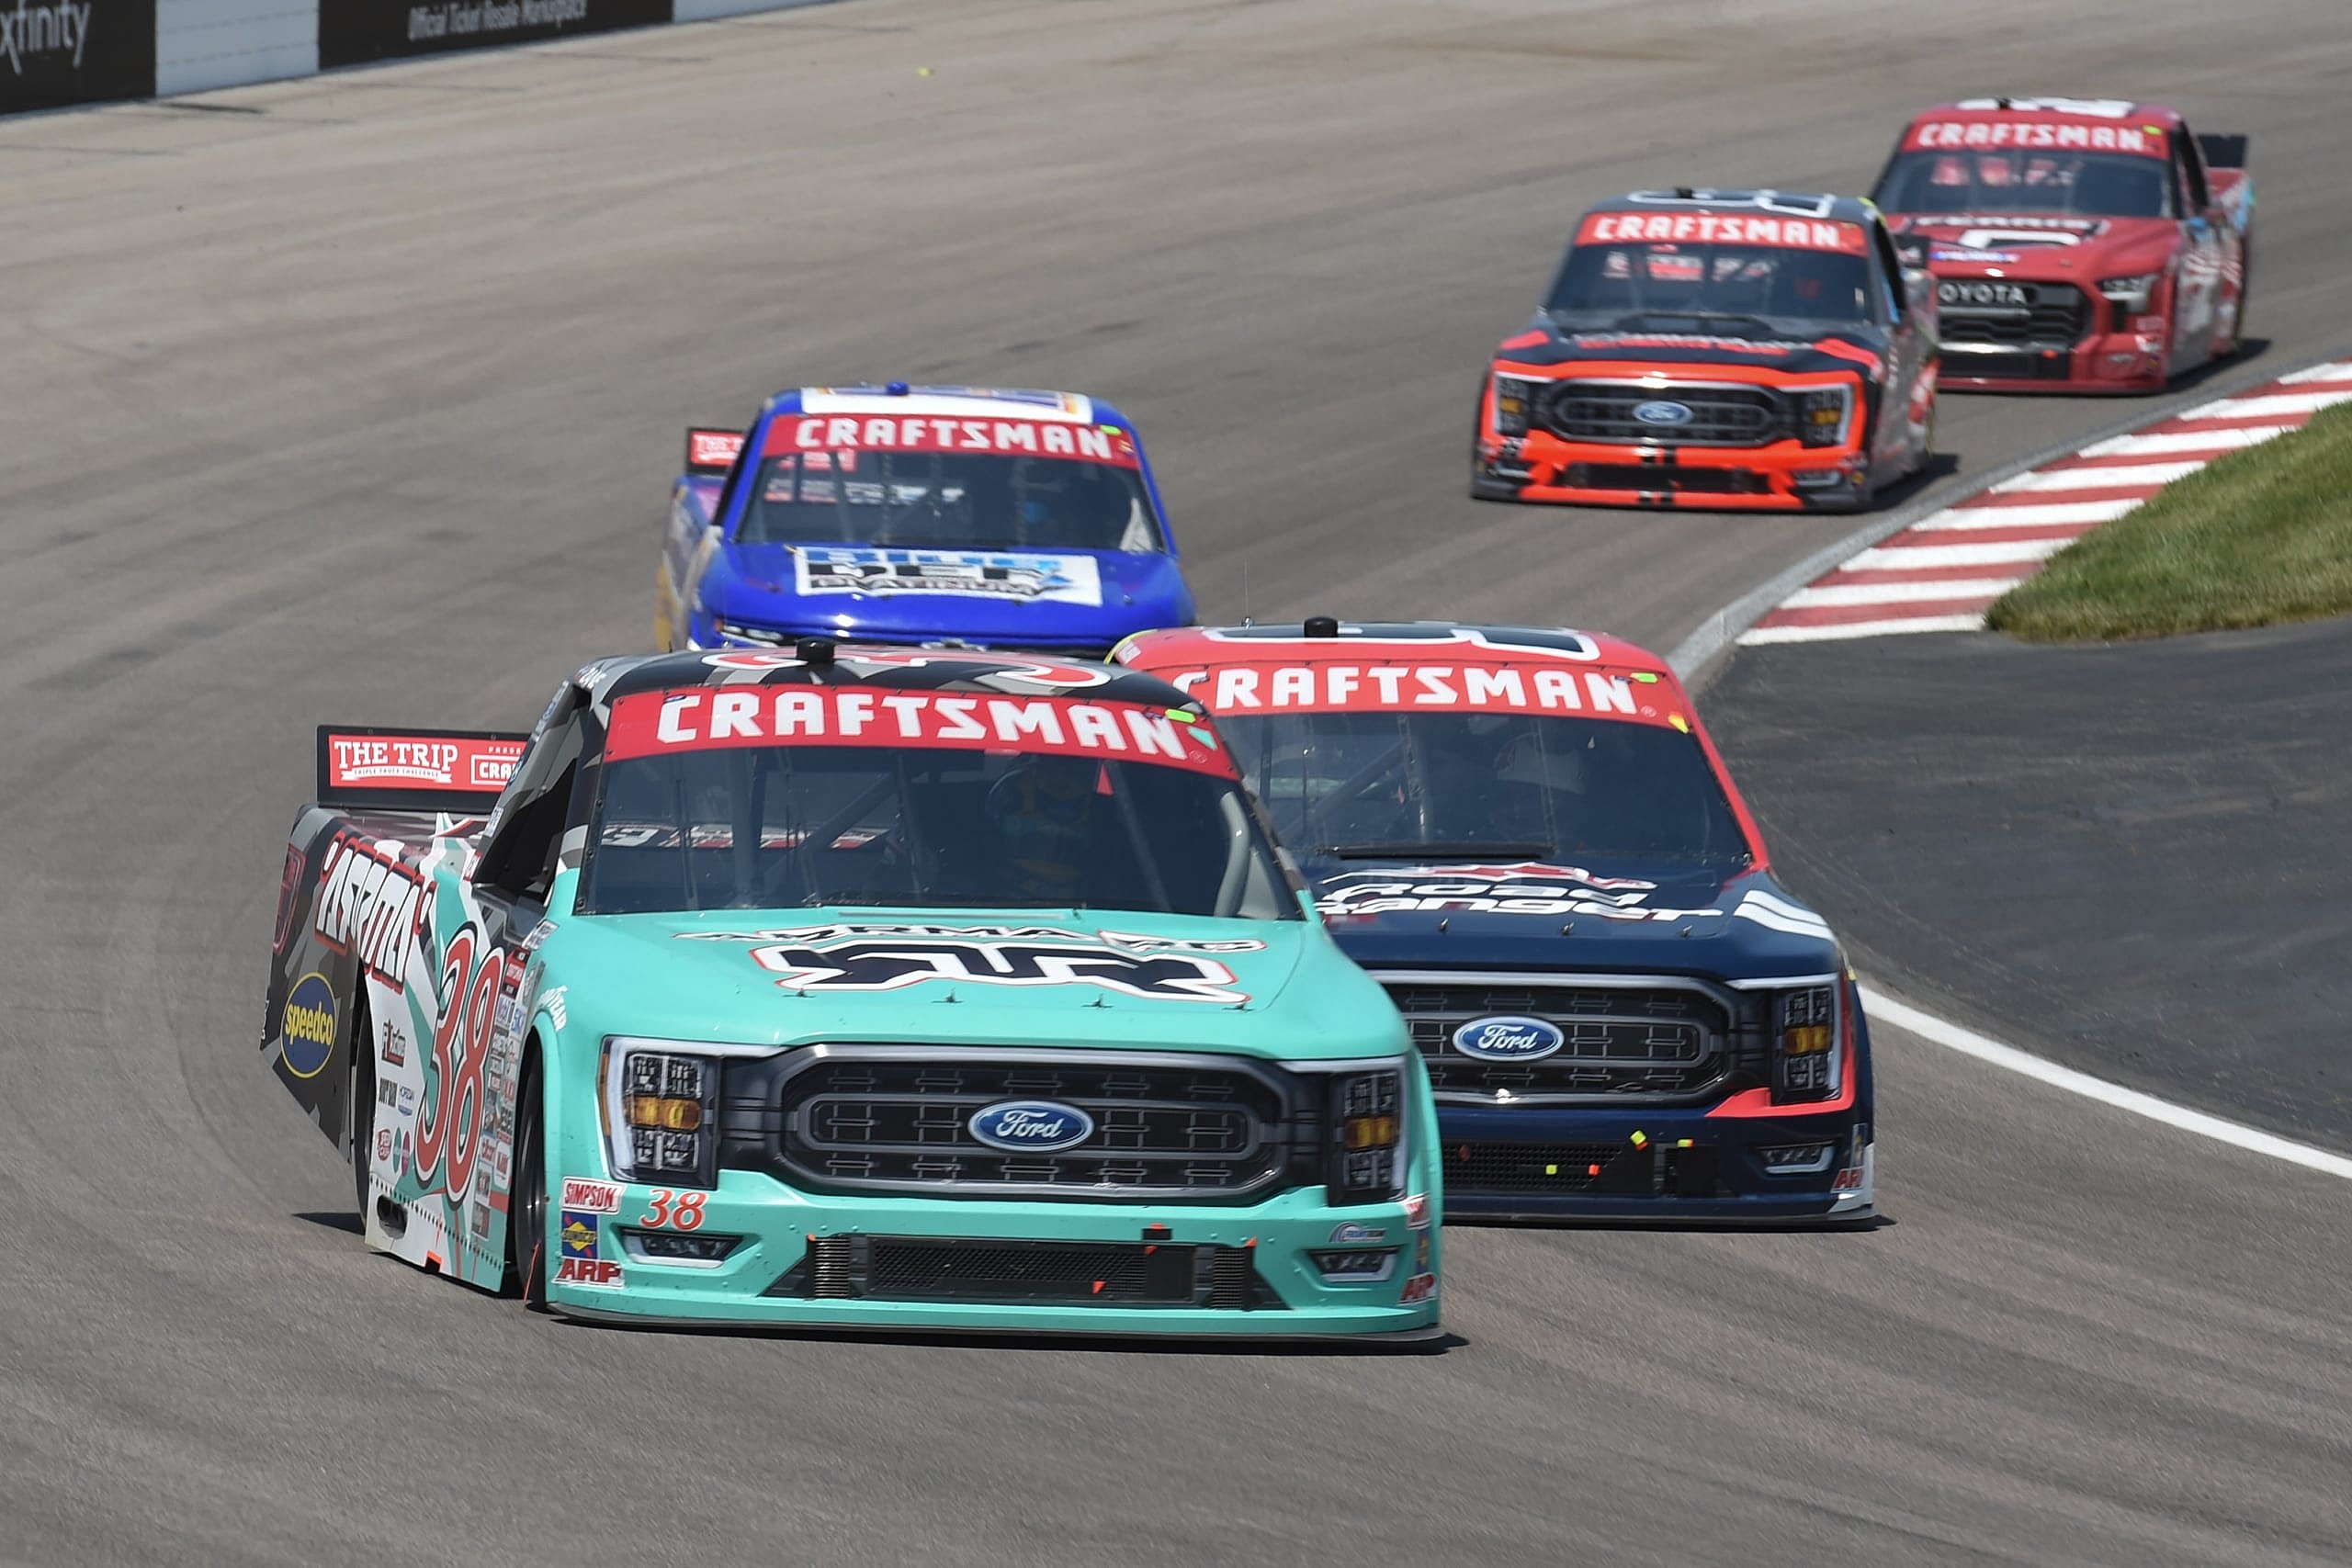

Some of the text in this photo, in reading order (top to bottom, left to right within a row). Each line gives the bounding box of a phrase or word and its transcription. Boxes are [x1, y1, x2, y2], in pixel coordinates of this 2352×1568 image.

[1918, 122, 2146, 152] CRAFTSMAN
[1593, 213, 1839, 248] CRAFTSMAN
[1938, 283, 2028, 305] OYOTA
[795, 417, 1113, 459] CRAFTSMAN
[1172, 666, 1638, 715] CRAFTSMAN
[656, 690, 1189, 761] CRAFTSMAN
[334, 740, 458, 773] THE TRIP
[479, 761, 515, 780] CRA
[284, 999, 335, 1047] speedco
[1477, 1023, 1538, 1052] Ford
[414, 921, 505, 1211] 38
[998, 1110, 1064, 1139] Ford
[565, 1182, 617, 1208] SIMPSON
[639, 1188, 709, 1232] 38
[557, 1258, 621, 1283] ARP
